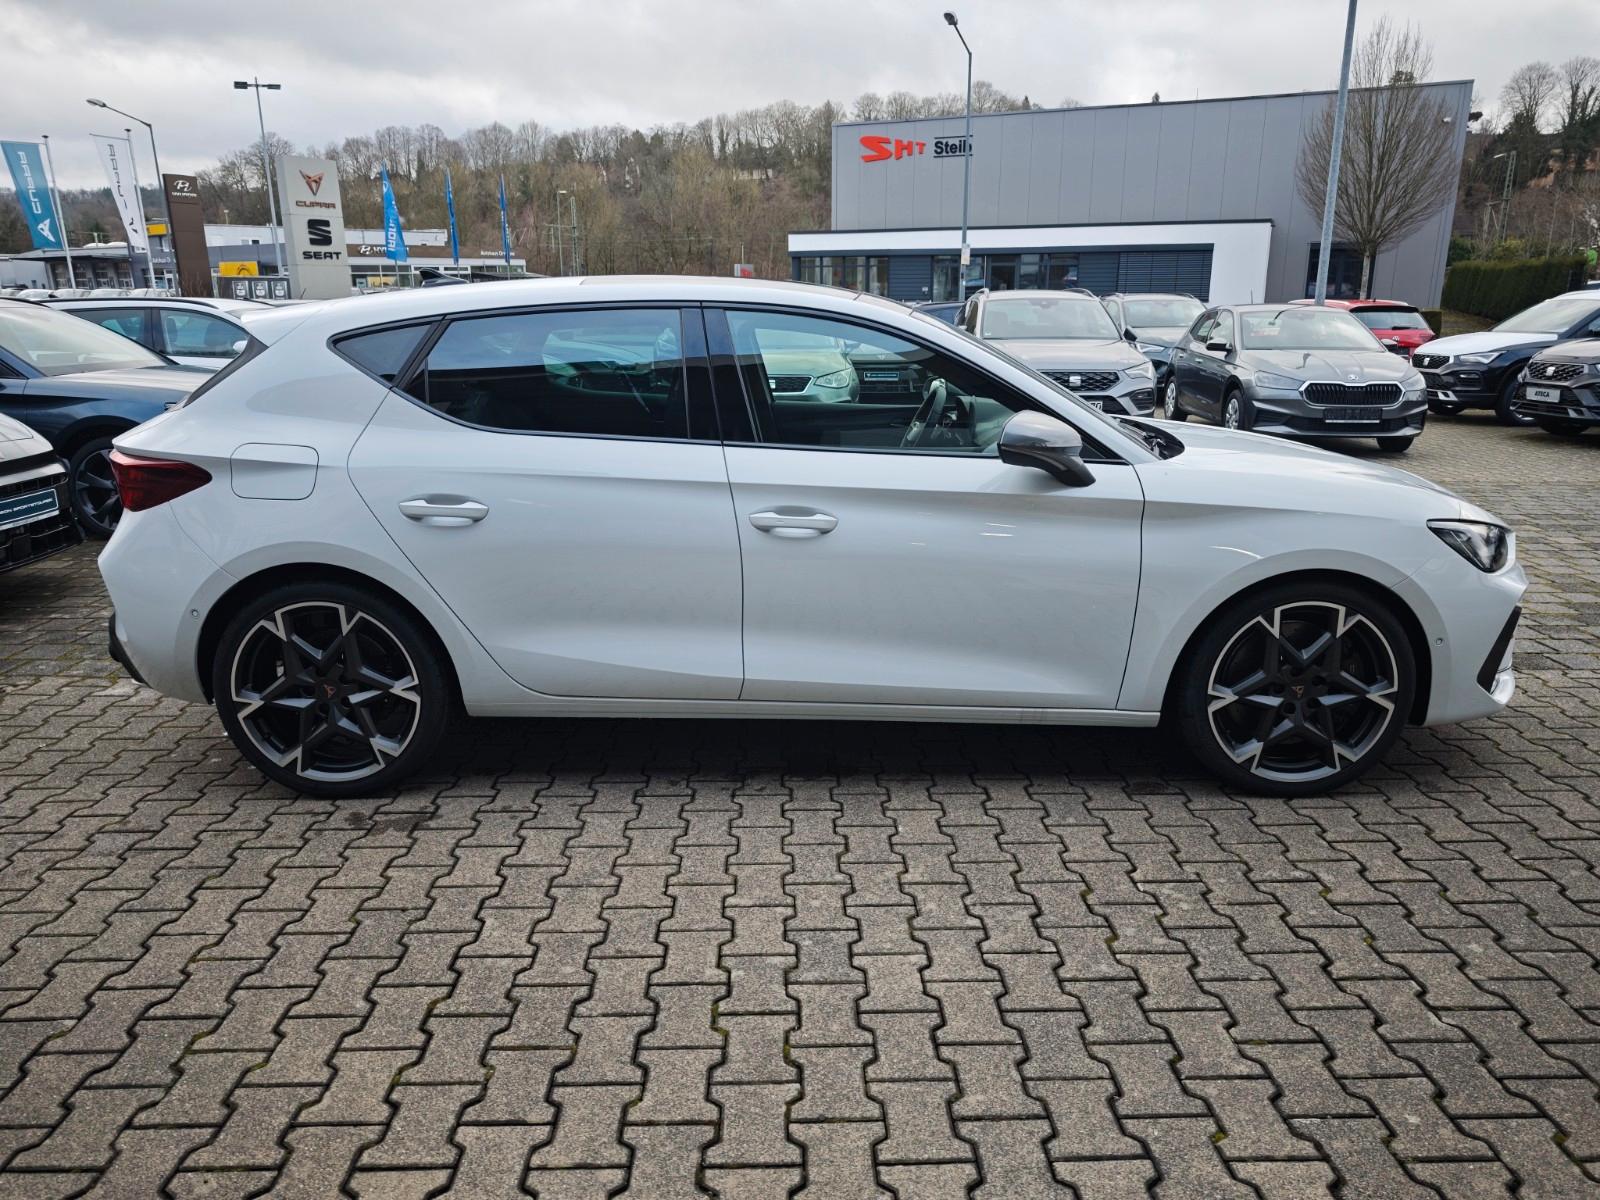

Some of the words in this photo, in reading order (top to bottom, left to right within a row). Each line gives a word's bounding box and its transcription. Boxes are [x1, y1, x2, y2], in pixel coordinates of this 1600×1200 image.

[860, 135, 926, 162] SHT
[296, 200, 336, 209] CUPRA
[302, 250, 342, 260] SEAT
